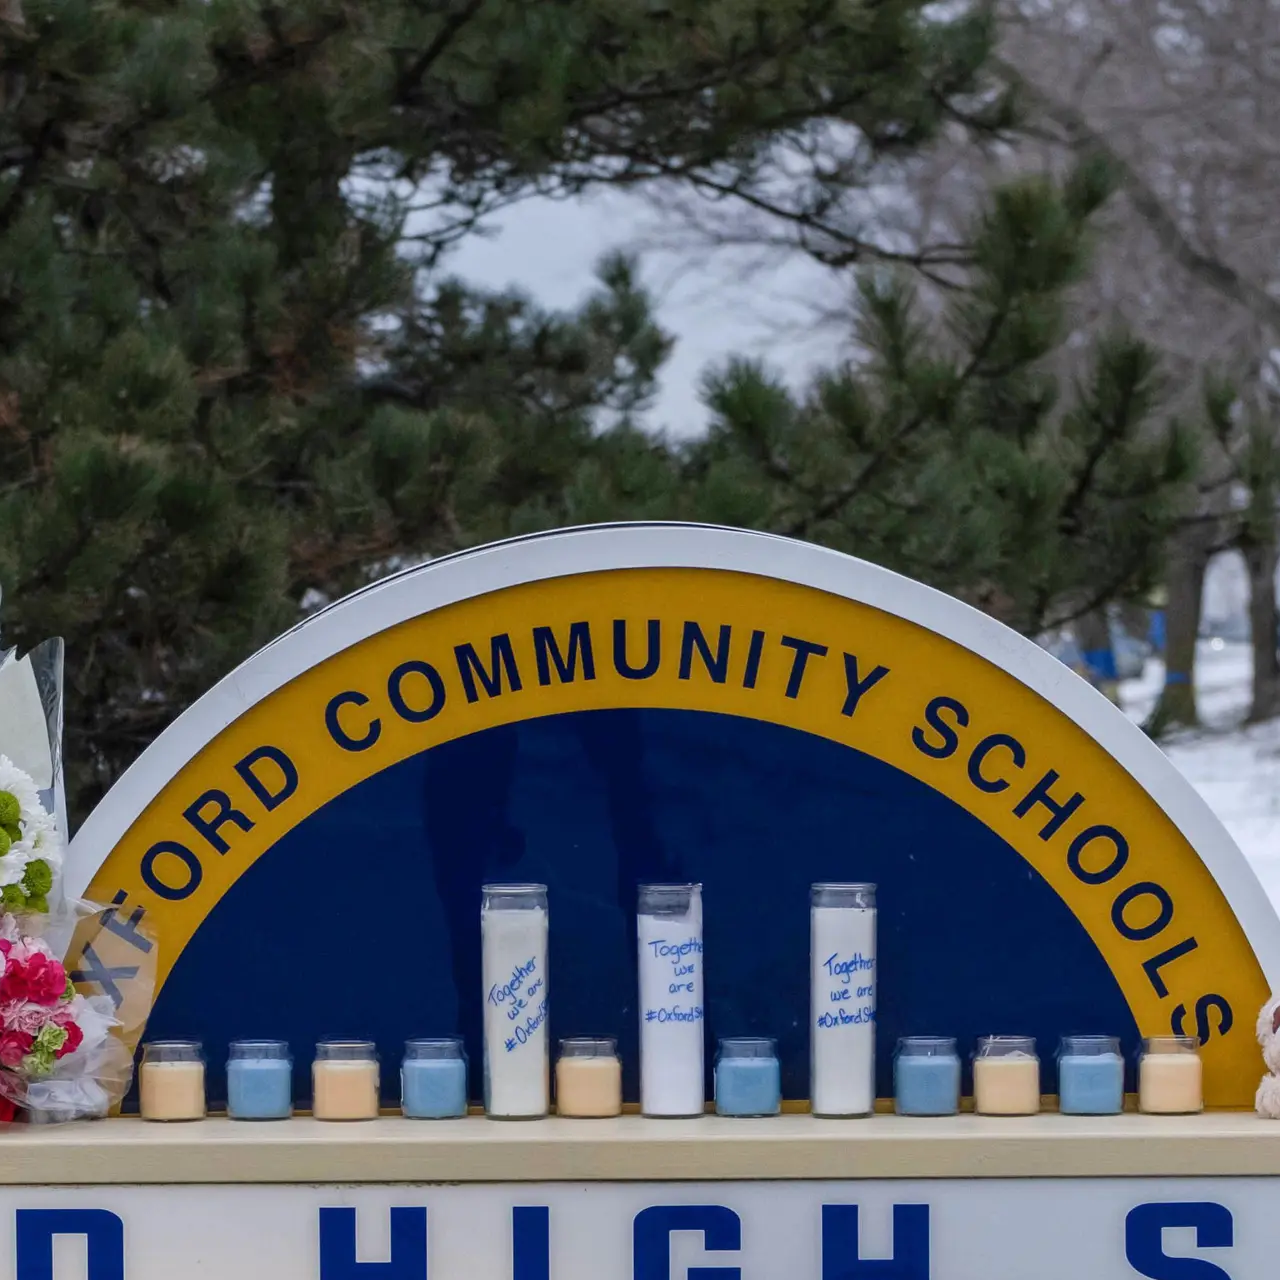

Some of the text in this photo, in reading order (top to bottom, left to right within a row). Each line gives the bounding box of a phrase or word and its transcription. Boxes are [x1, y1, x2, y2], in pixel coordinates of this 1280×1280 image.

[70, 619, 1234, 1049] XFORD COMMUNITY SCHOOLS
[487, 955, 537, 1007] Together
[674, 963, 695, 977] we
[507, 977, 544, 1021] we are
[668, 981, 695, 994] are
[830, 984, 873, 1002] we are
